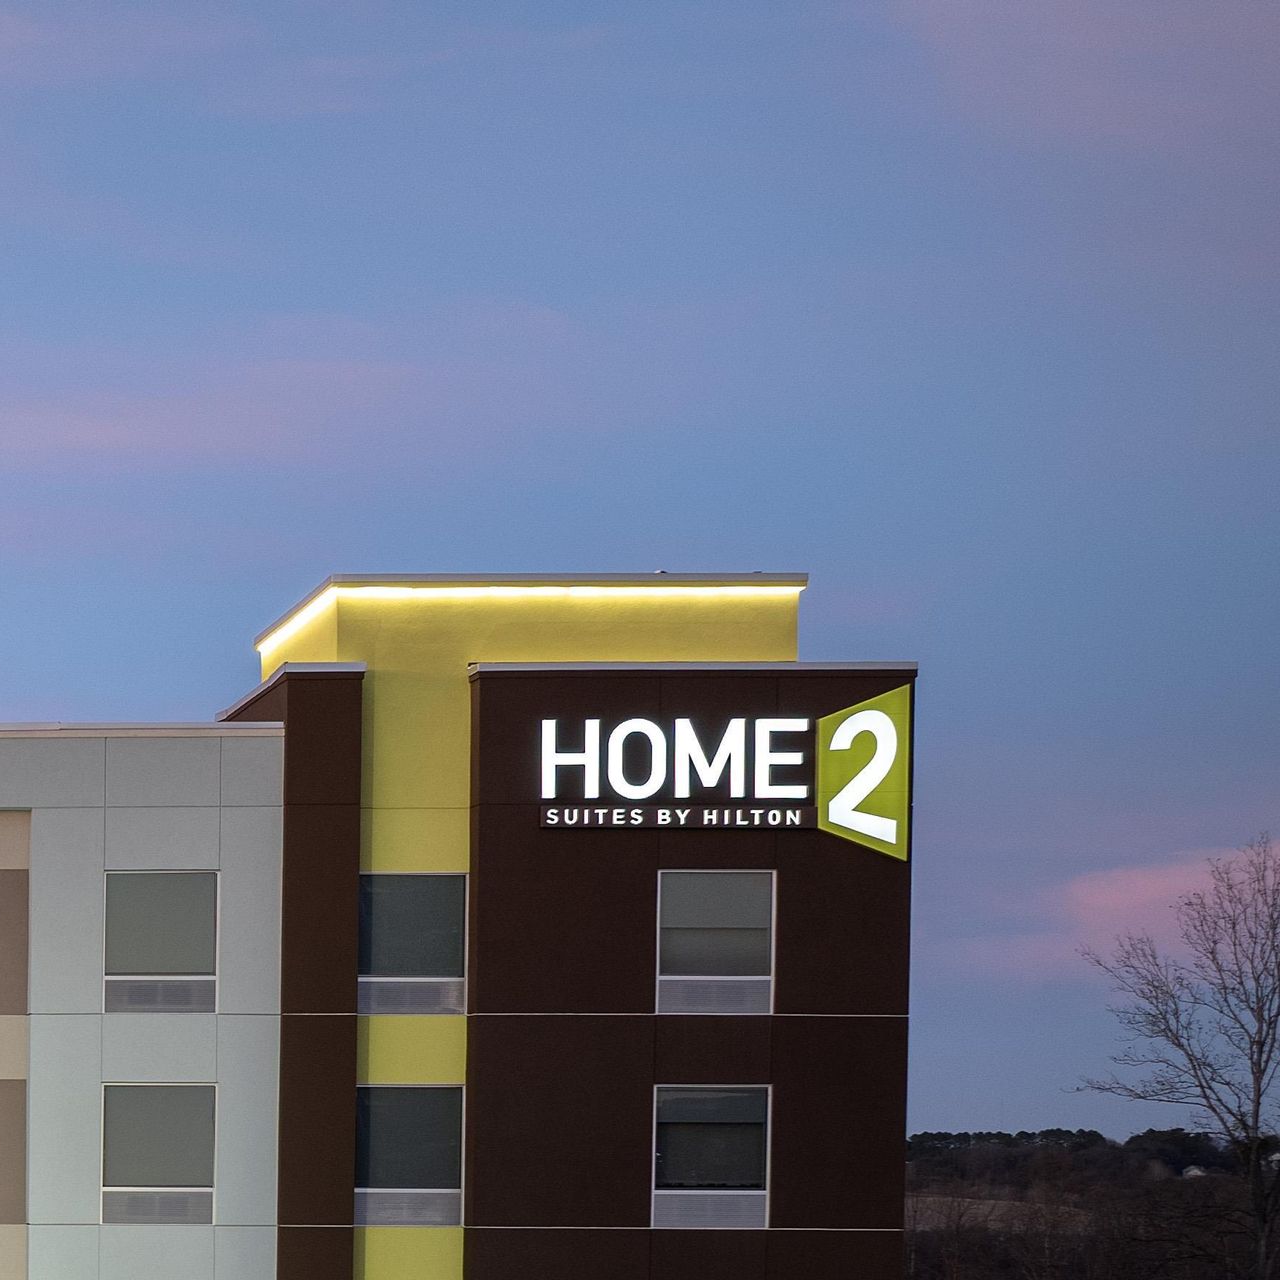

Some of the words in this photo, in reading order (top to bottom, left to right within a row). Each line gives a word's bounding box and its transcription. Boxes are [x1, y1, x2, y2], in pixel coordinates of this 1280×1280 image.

[541, 718, 810, 800] HOME
[828, 709, 898, 844] 2
[546, 808, 644, 826] SUITES
[657, 808, 691, 826] BY
[703, 809, 803, 826] HILTON
